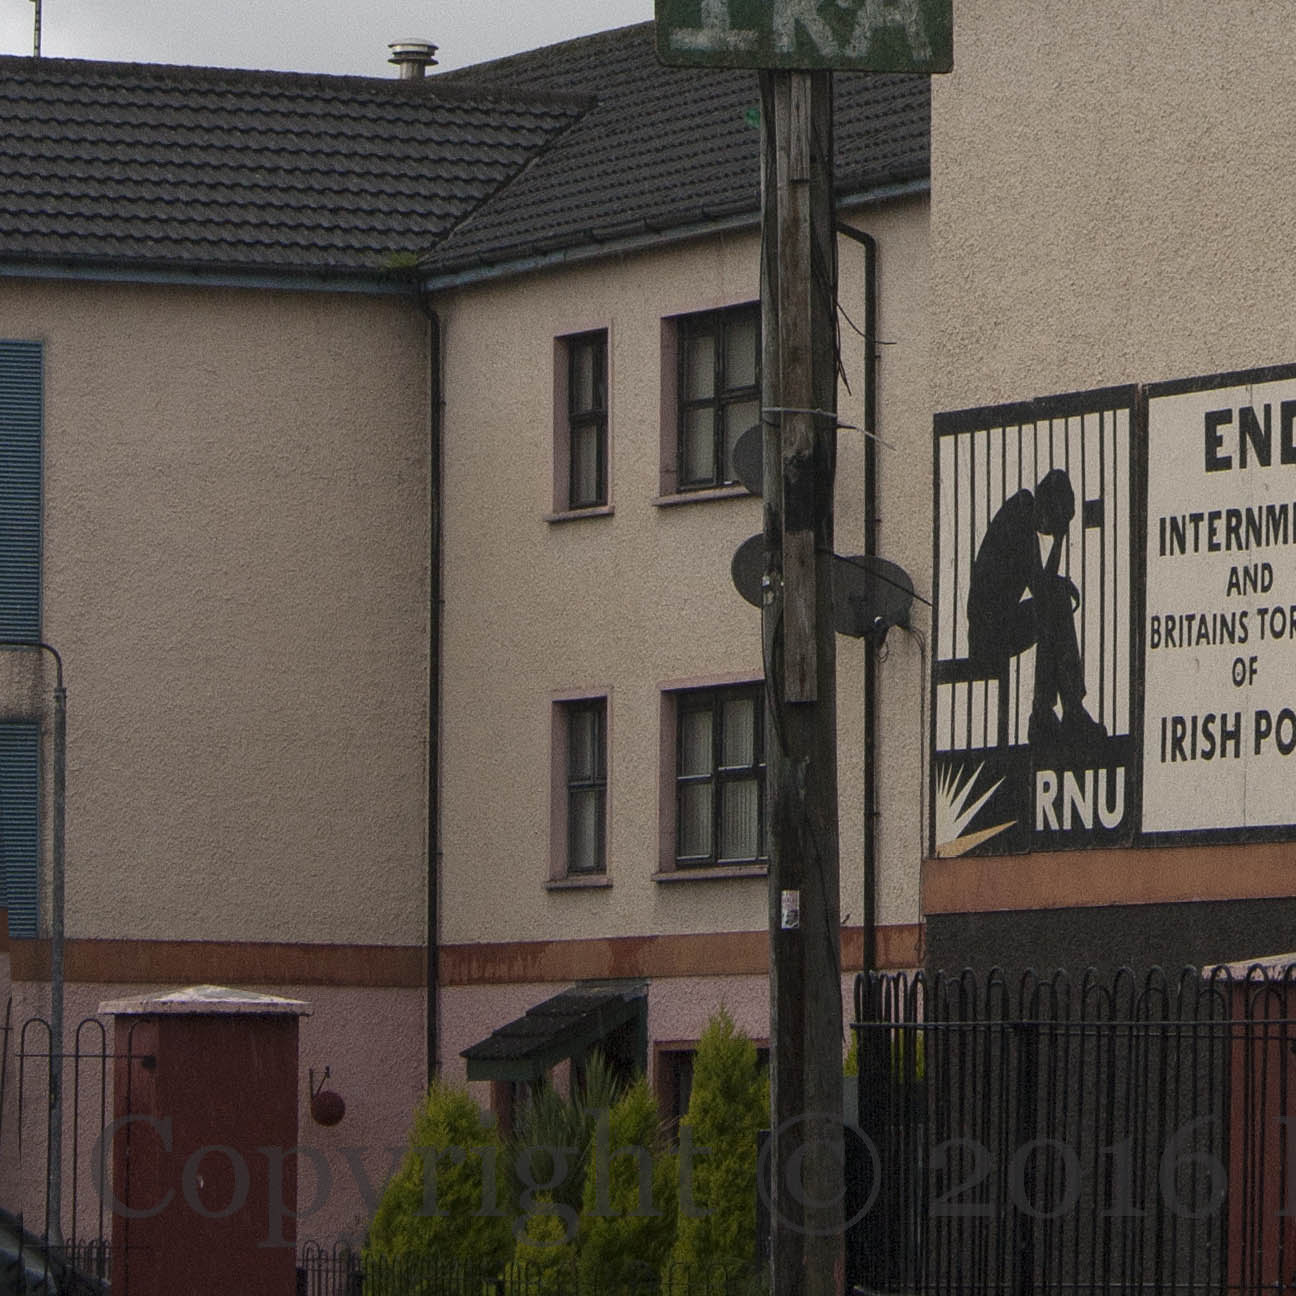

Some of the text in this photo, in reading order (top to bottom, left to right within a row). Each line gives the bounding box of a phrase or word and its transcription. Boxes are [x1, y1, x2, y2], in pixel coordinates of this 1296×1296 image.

[1226, 562, 1274, 597] AND
[1150, 610, 1249, 649] BRITAINS
[1231, 656, 1258, 688] OF
[1160, 712, 1241, 764] IRISH
[1035, 767, 1126, 832] RNU
